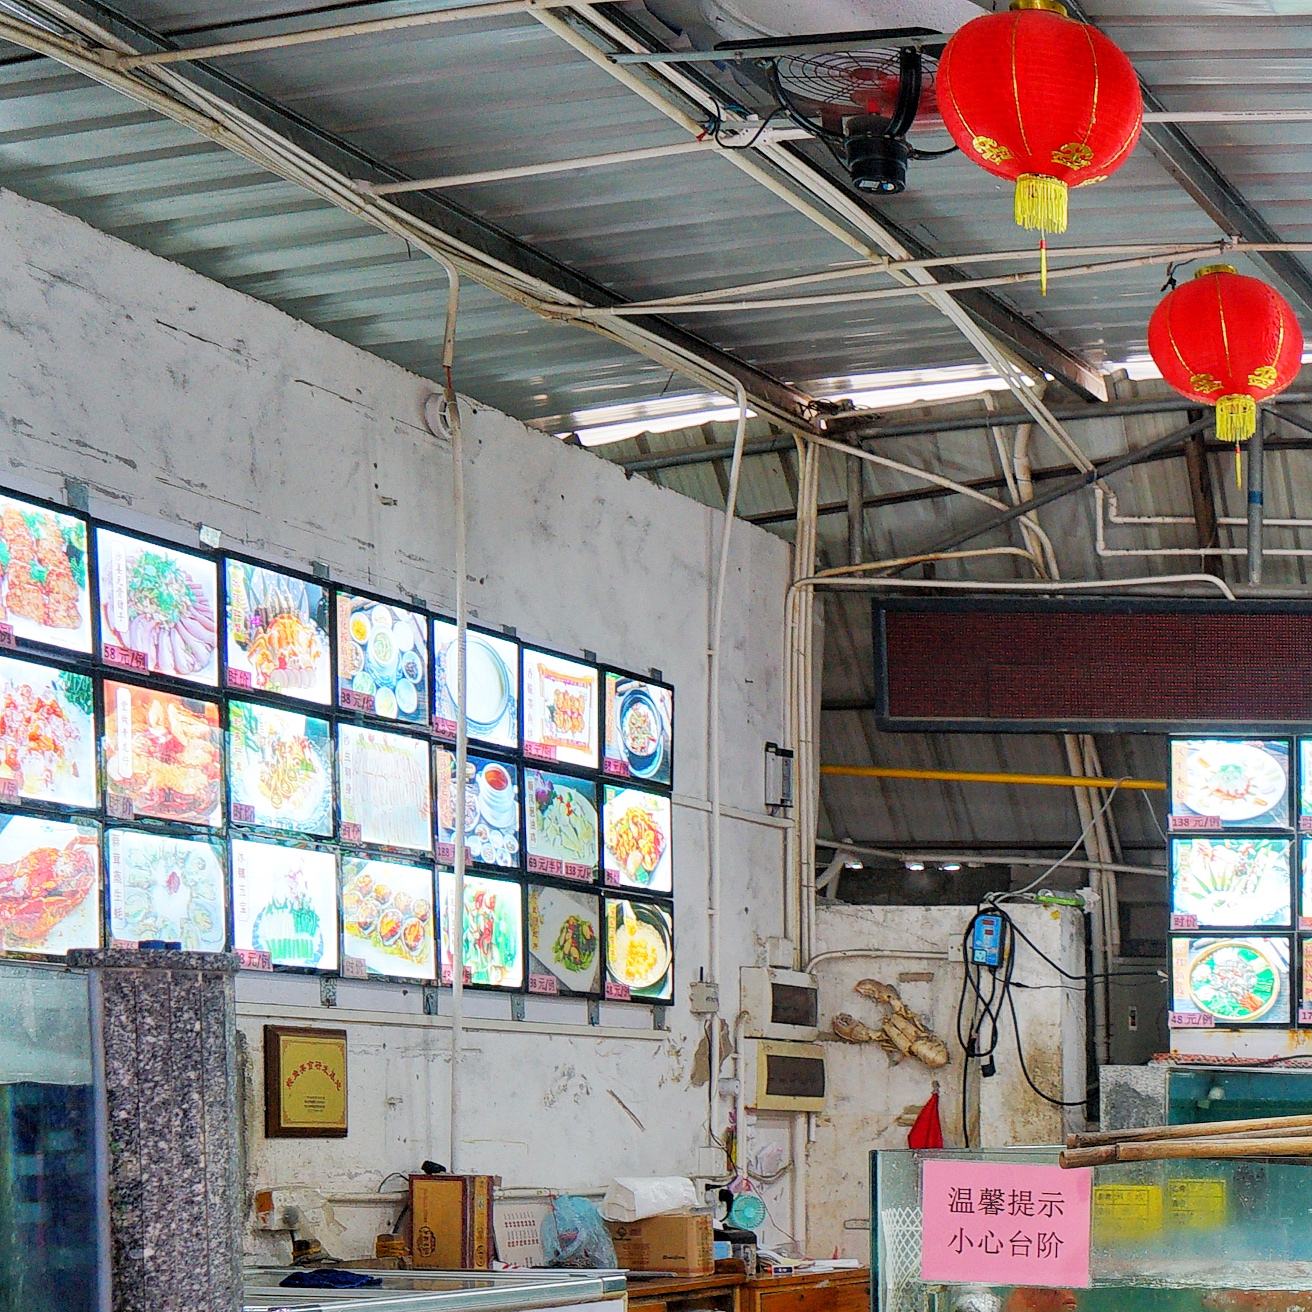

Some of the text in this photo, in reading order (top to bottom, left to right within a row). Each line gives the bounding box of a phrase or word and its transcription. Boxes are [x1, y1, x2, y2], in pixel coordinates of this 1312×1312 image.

[104, 645, 116, 660] 58
[1173, 818, 1220, 826] 138 元/例
[1175, 917, 1196, 926] 时价
[1186, 1016, 1213, 1025] 元/例
[948, 1186, 1066, 1219] 温馨提示
[948, 1227, 1065, 1259] 小心台阶
